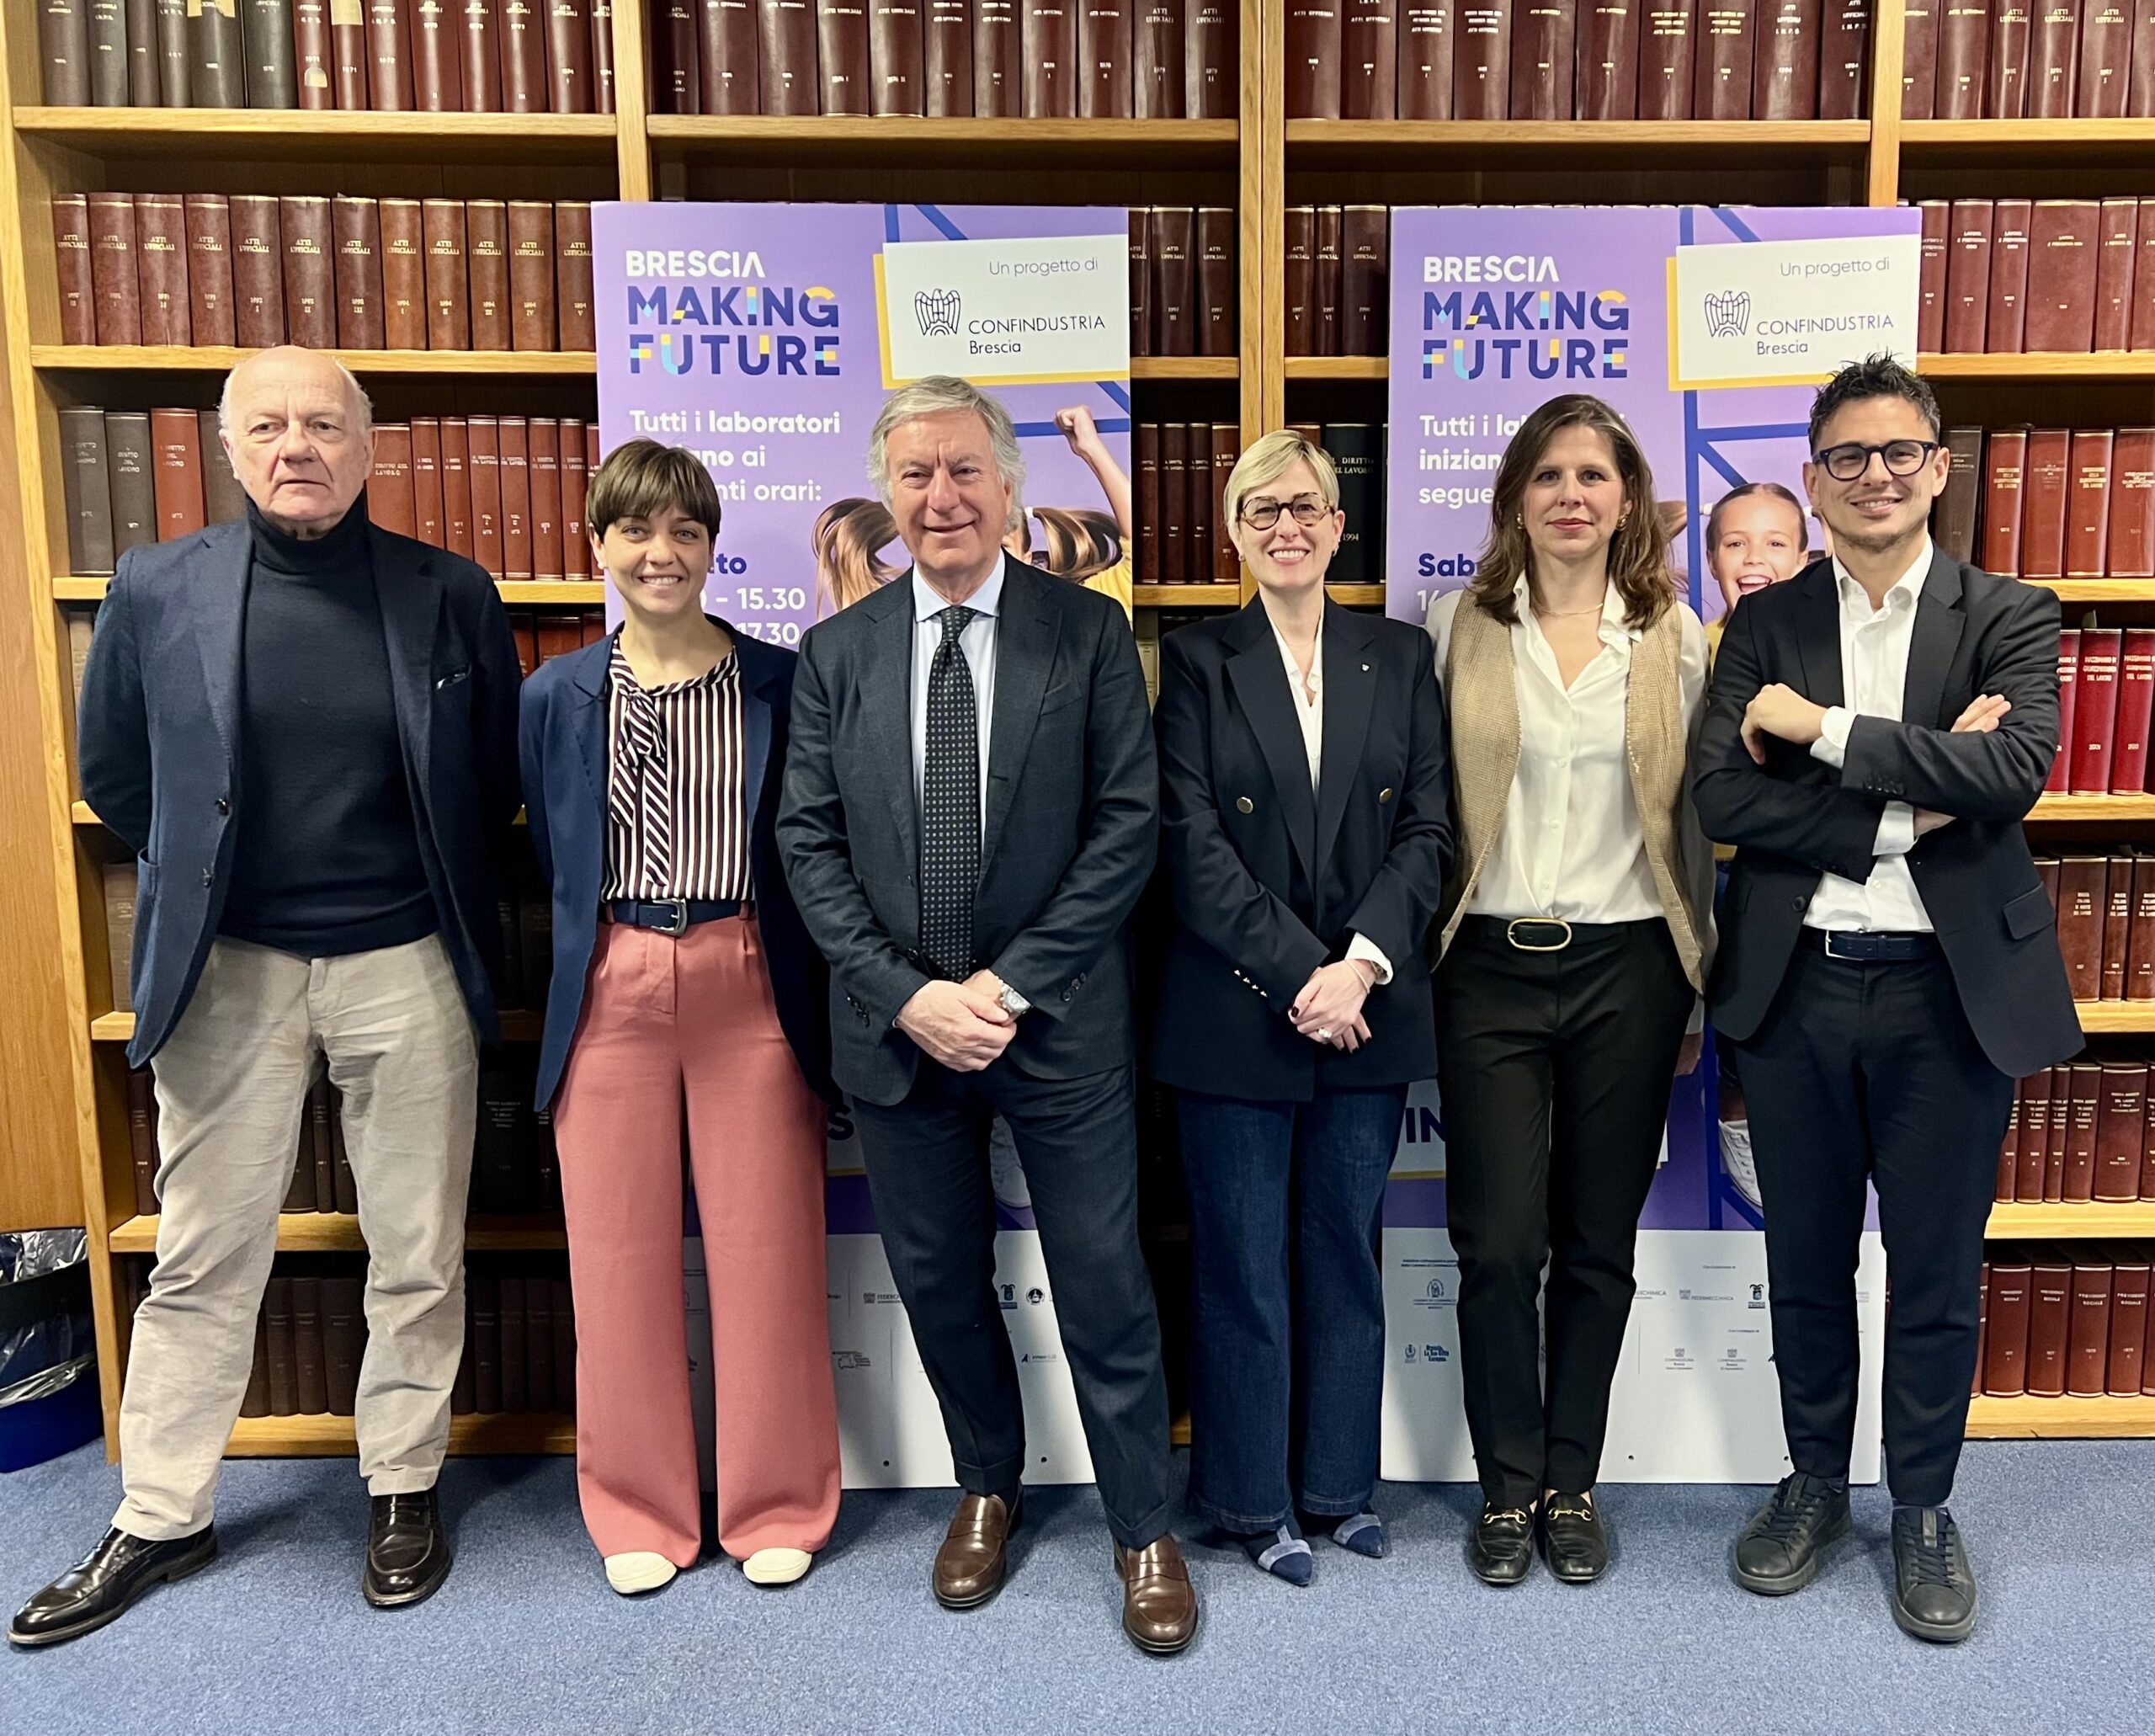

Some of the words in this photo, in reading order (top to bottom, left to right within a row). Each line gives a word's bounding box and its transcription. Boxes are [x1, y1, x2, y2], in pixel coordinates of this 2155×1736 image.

[625, 250, 765, 278] BRESCIA
[989, 261, 1010, 275] Un
[1014, 259, 1080, 277] progetto
[1084, 257, 1098, 271] di
[1423, 255, 1560, 283] BRESCIA
[1780, 263, 1801, 276] Un
[1805, 259, 1871, 278] progetto
[1876, 257, 1890, 271] di
[627, 285, 839, 327] MAKING
[1423, 290, 1630, 331] MAKING
[968, 315, 1105, 334] CONFINDUSTRIA
[1757, 315, 1894, 335] CONFINDUSTRIA
[630, 333, 840, 376] FUTURE
[970, 339, 1021, 354] Brescia
[1757, 339, 1808, 355] Brescia
[1423, 338, 1628, 380] FUTURE
[629, 410, 687, 432] Tutti
[694, 410, 701, 432] i
[709, 410, 841, 434] laboratori
[1419, 414, 1475, 437] Tutti
[1482, 415, 1488, 437] i
[742, 445, 766, 467] ai
[1419, 449, 1502, 471] inizian
[753, 479, 822, 501] orari:
[1418, 487, 1494, 509] segue
[737, 588, 806, 610] 15.30
